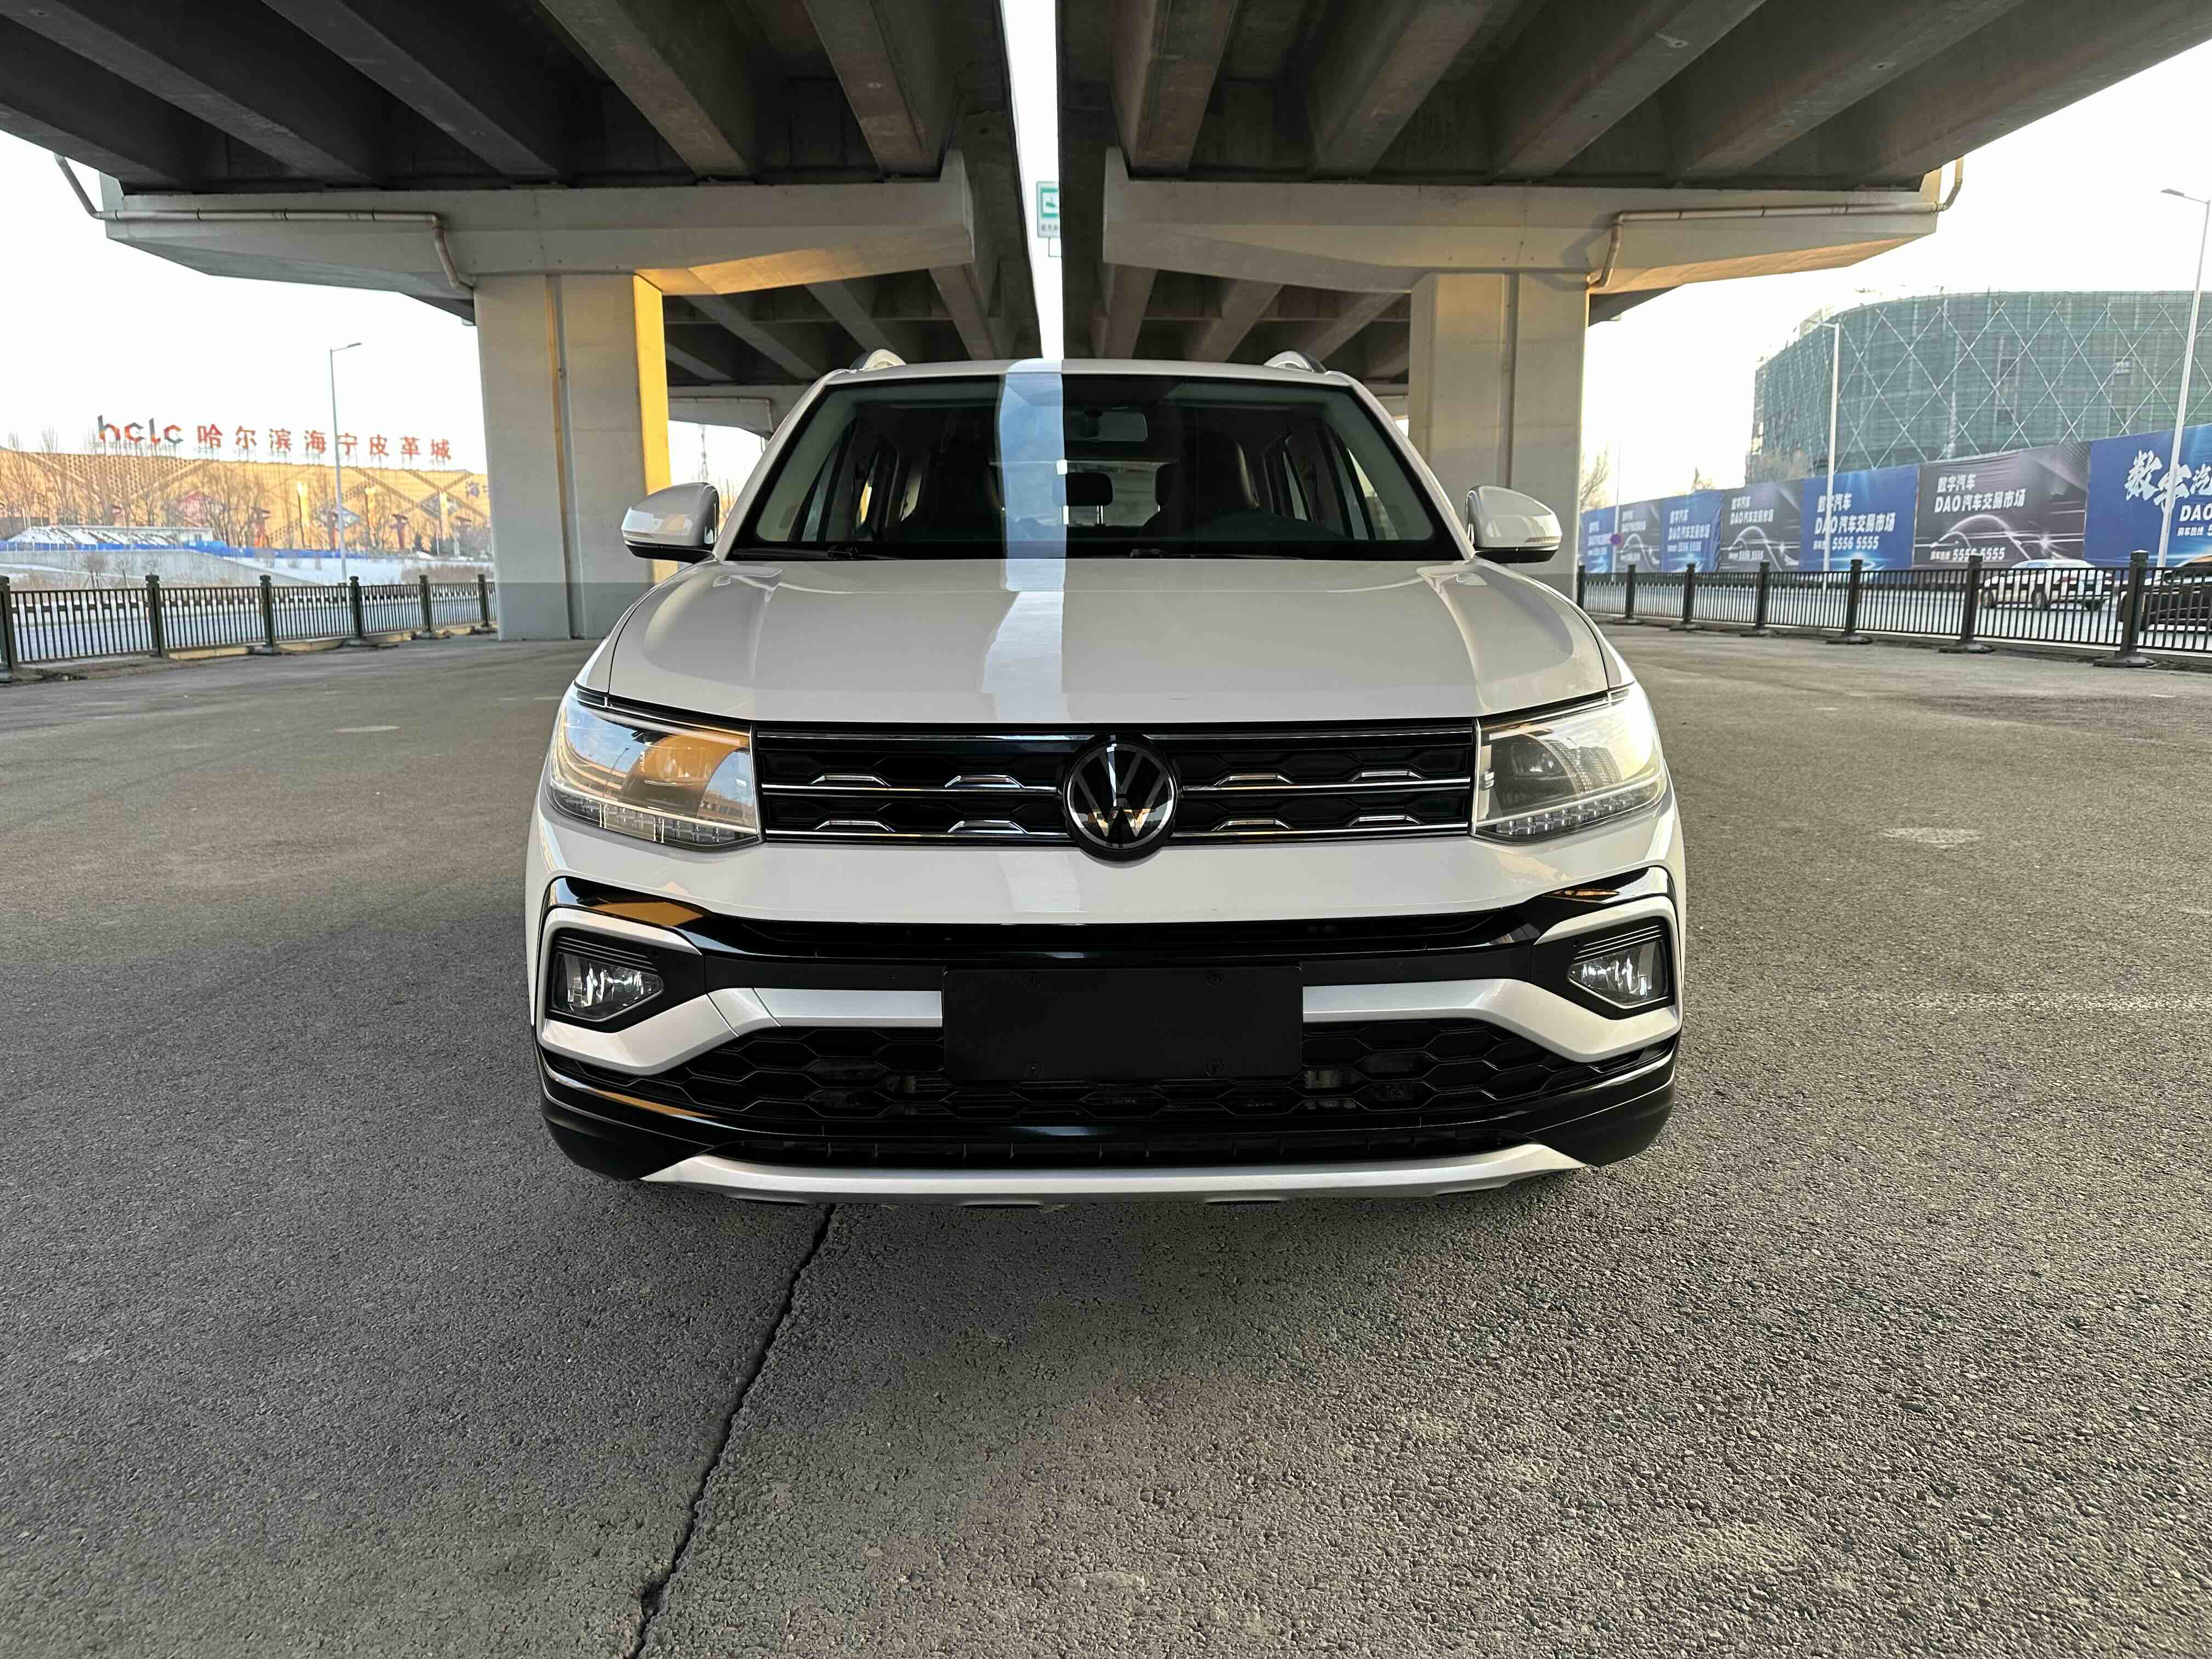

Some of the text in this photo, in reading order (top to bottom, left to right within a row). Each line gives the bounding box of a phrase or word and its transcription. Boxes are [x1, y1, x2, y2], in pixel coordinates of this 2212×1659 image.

[197, 424, 452, 460] 哈尔滨海宁皮革城
[1937, 473, 1976, 493] 数字汽车
[1934, 488, 2027, 513] DAO 汽车交易市场
[1838, 512, 1896, 534] 汽车交易市场
[2179, 503, 2212, 522] DAO
[1831, 536, 1854, 551] 5556
[1855, 535, 1879, 550] 5555
